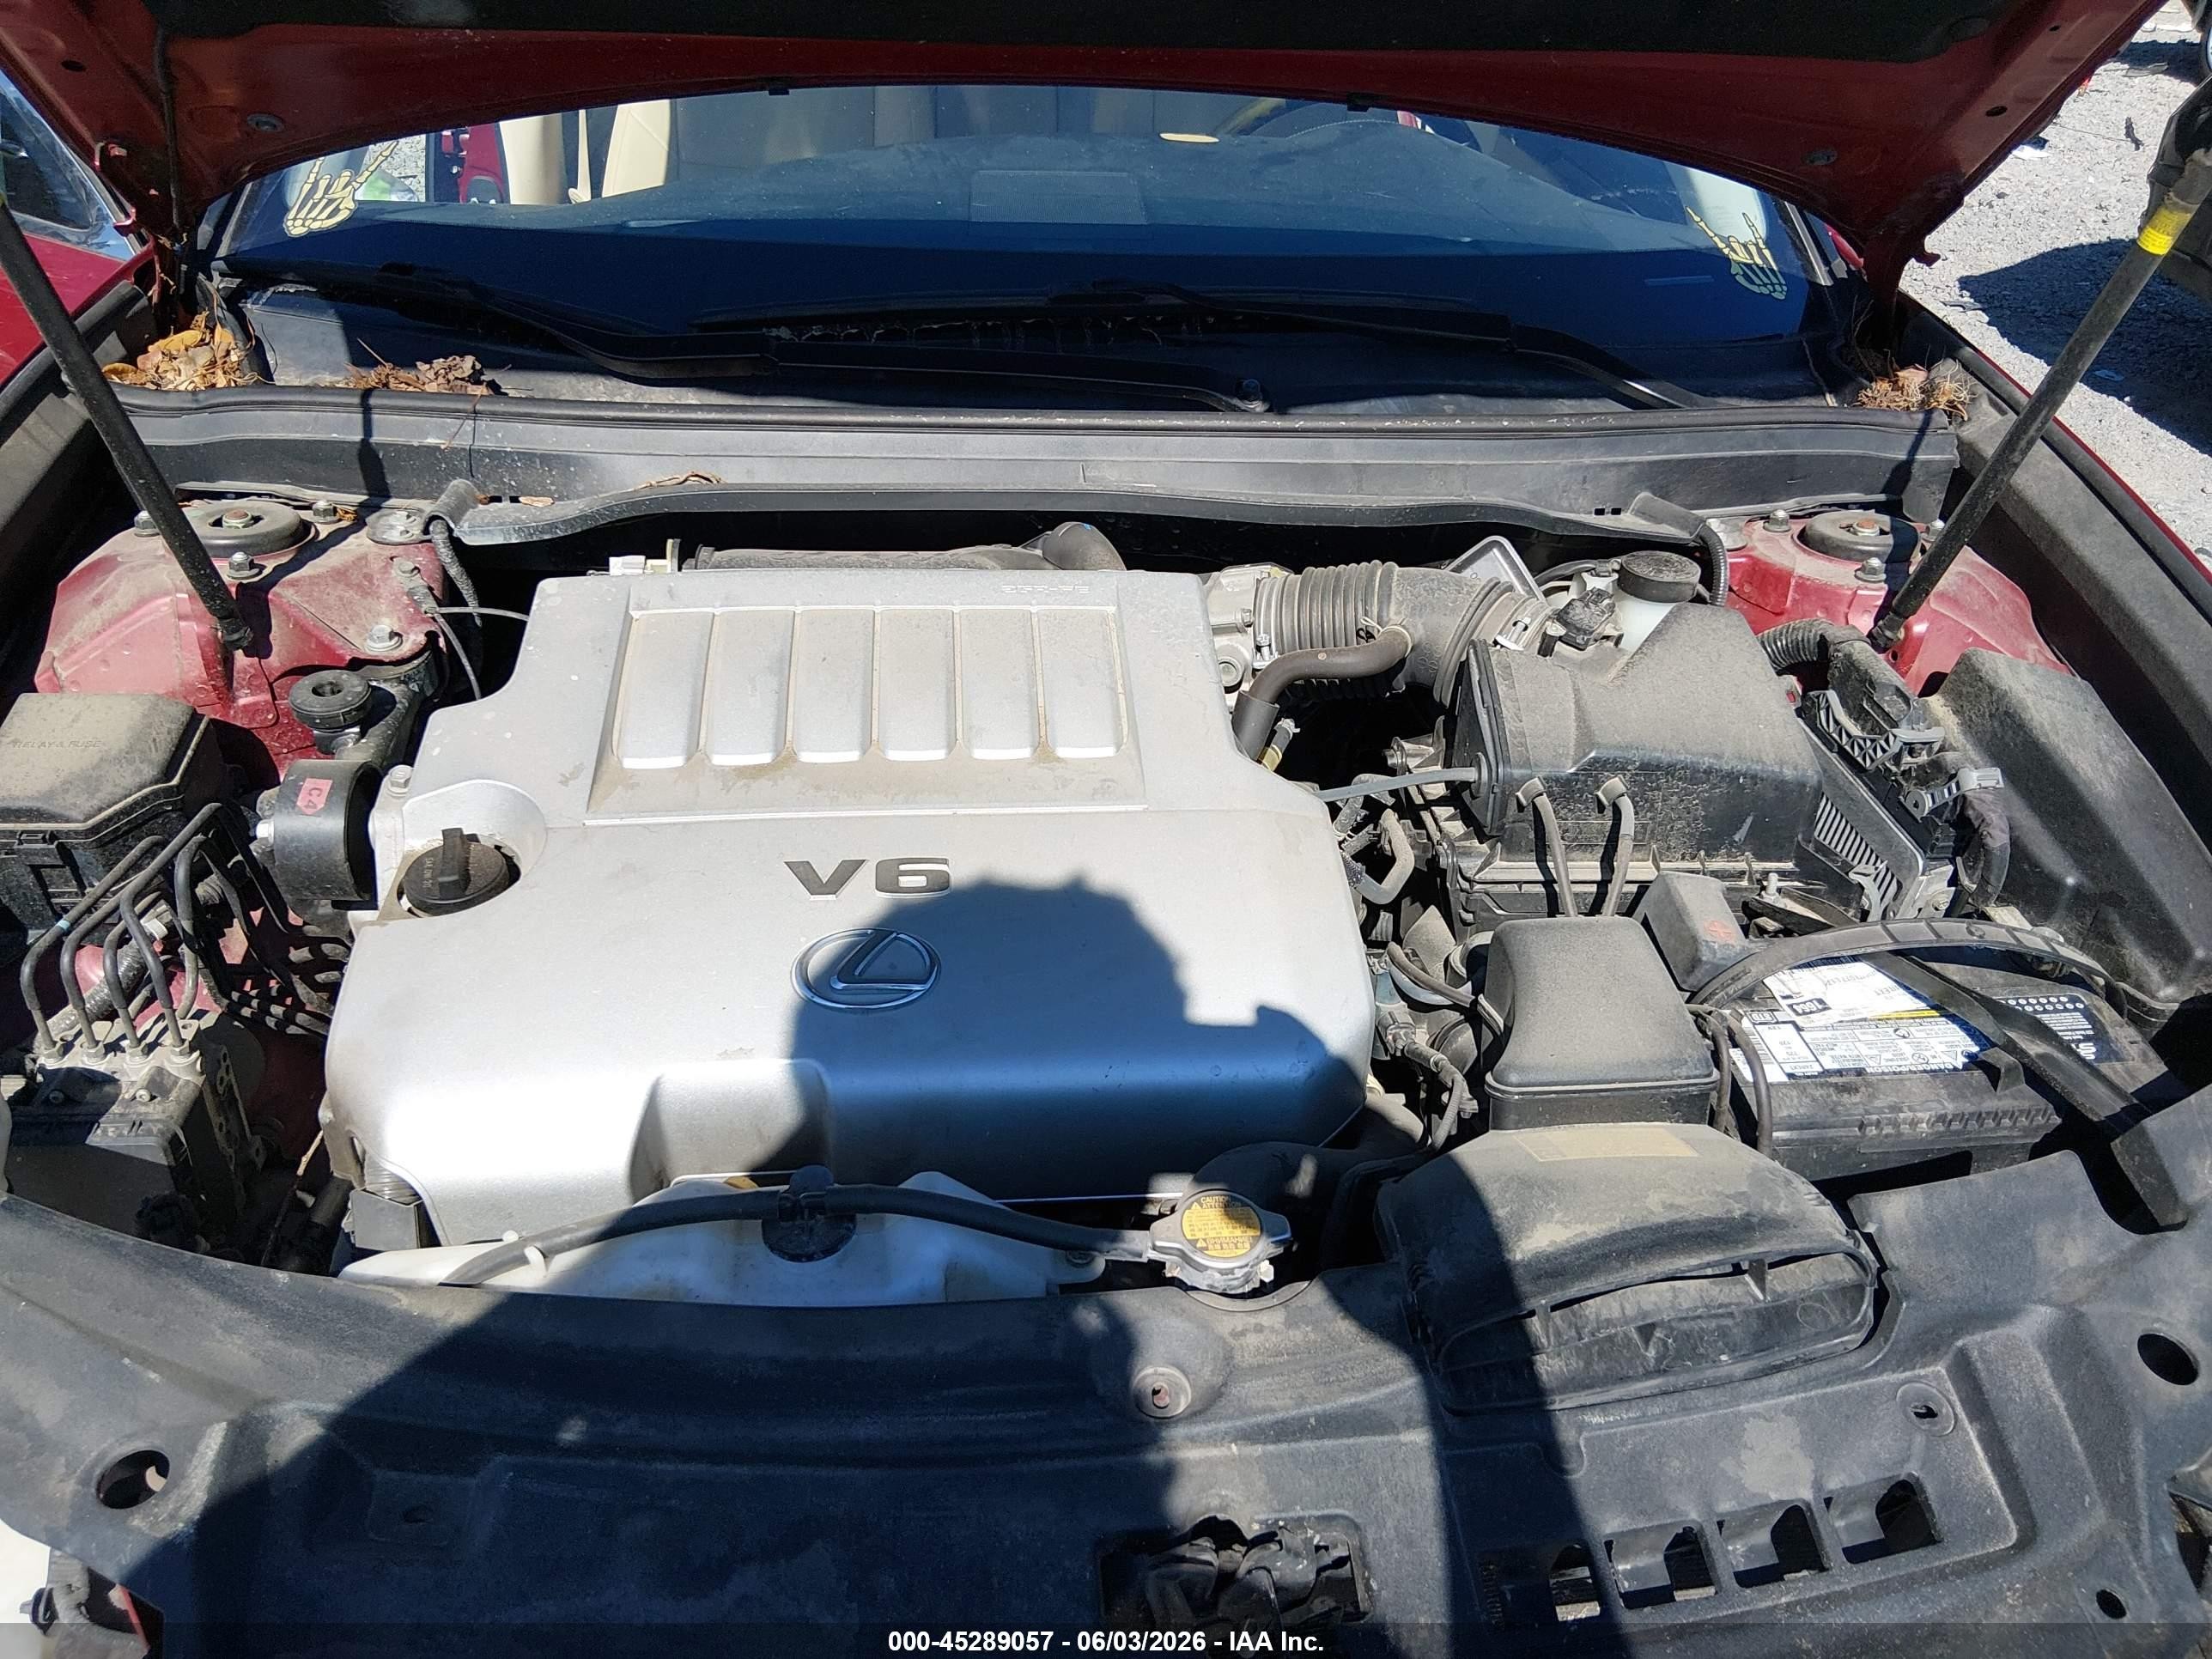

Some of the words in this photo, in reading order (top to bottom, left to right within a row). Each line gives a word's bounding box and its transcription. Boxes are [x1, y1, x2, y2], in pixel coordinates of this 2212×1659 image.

[68, 740, 102, 749] FUSE
[783, 857, 951, 899] V6
[1792, 1000, 1822, 1013] 1664
[1752, 1012, 1772, 1021] STD
[1865, 1062, 1954, 1074] DANGER/POISON
